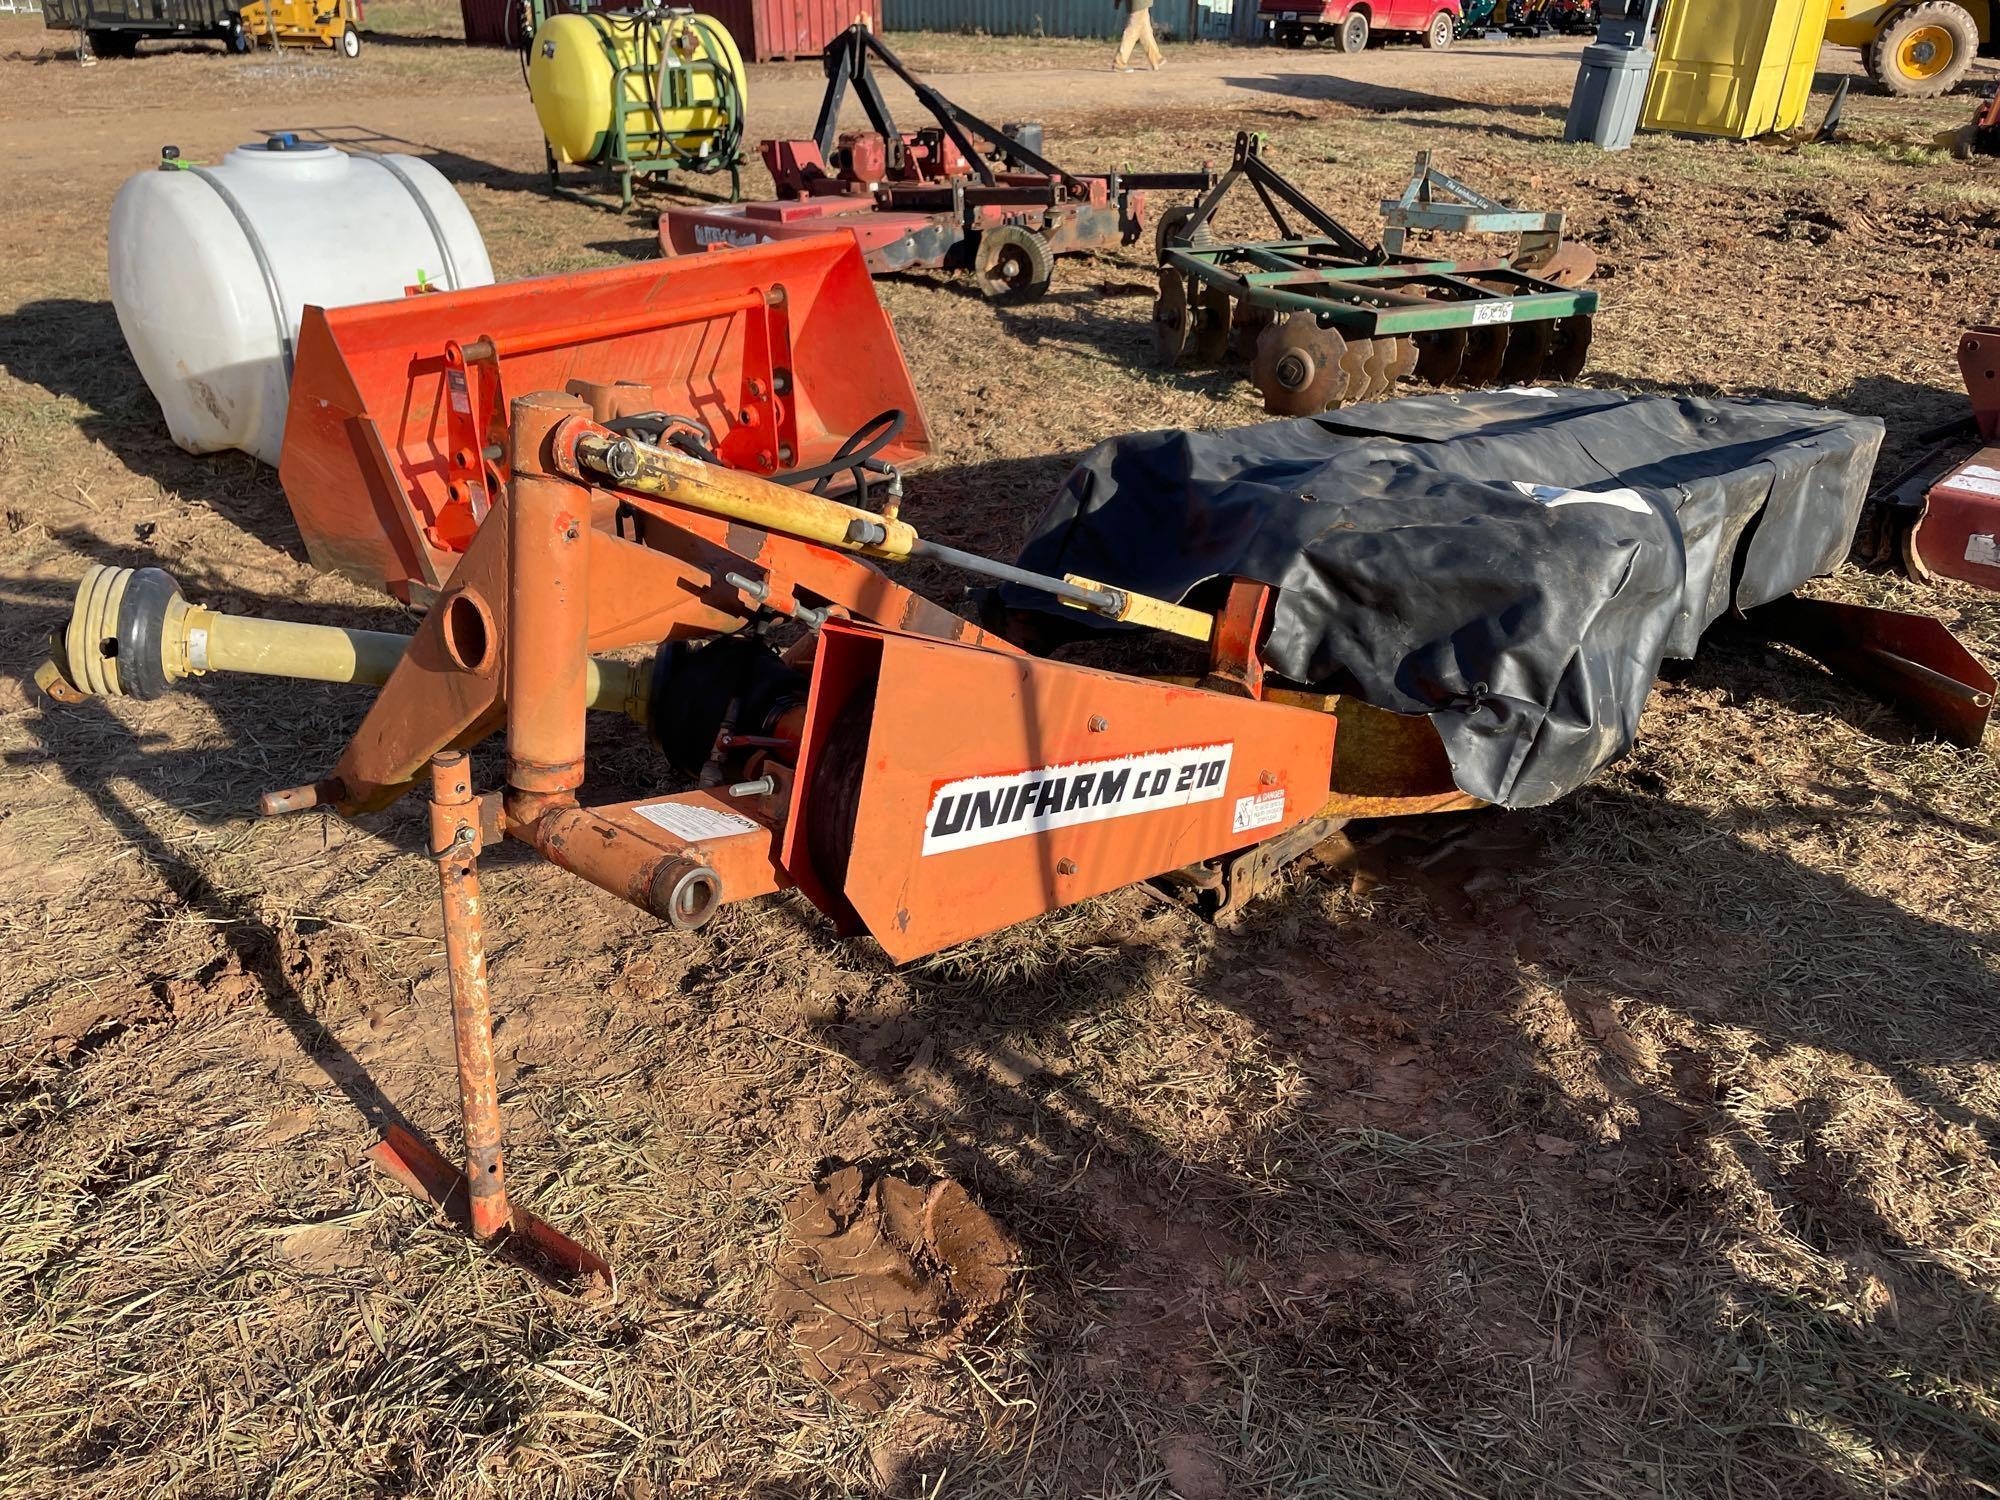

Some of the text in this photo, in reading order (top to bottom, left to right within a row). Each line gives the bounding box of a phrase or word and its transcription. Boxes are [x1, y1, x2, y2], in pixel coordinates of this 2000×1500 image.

[931, 759, 1227, 838] UNIFARM CD 210
